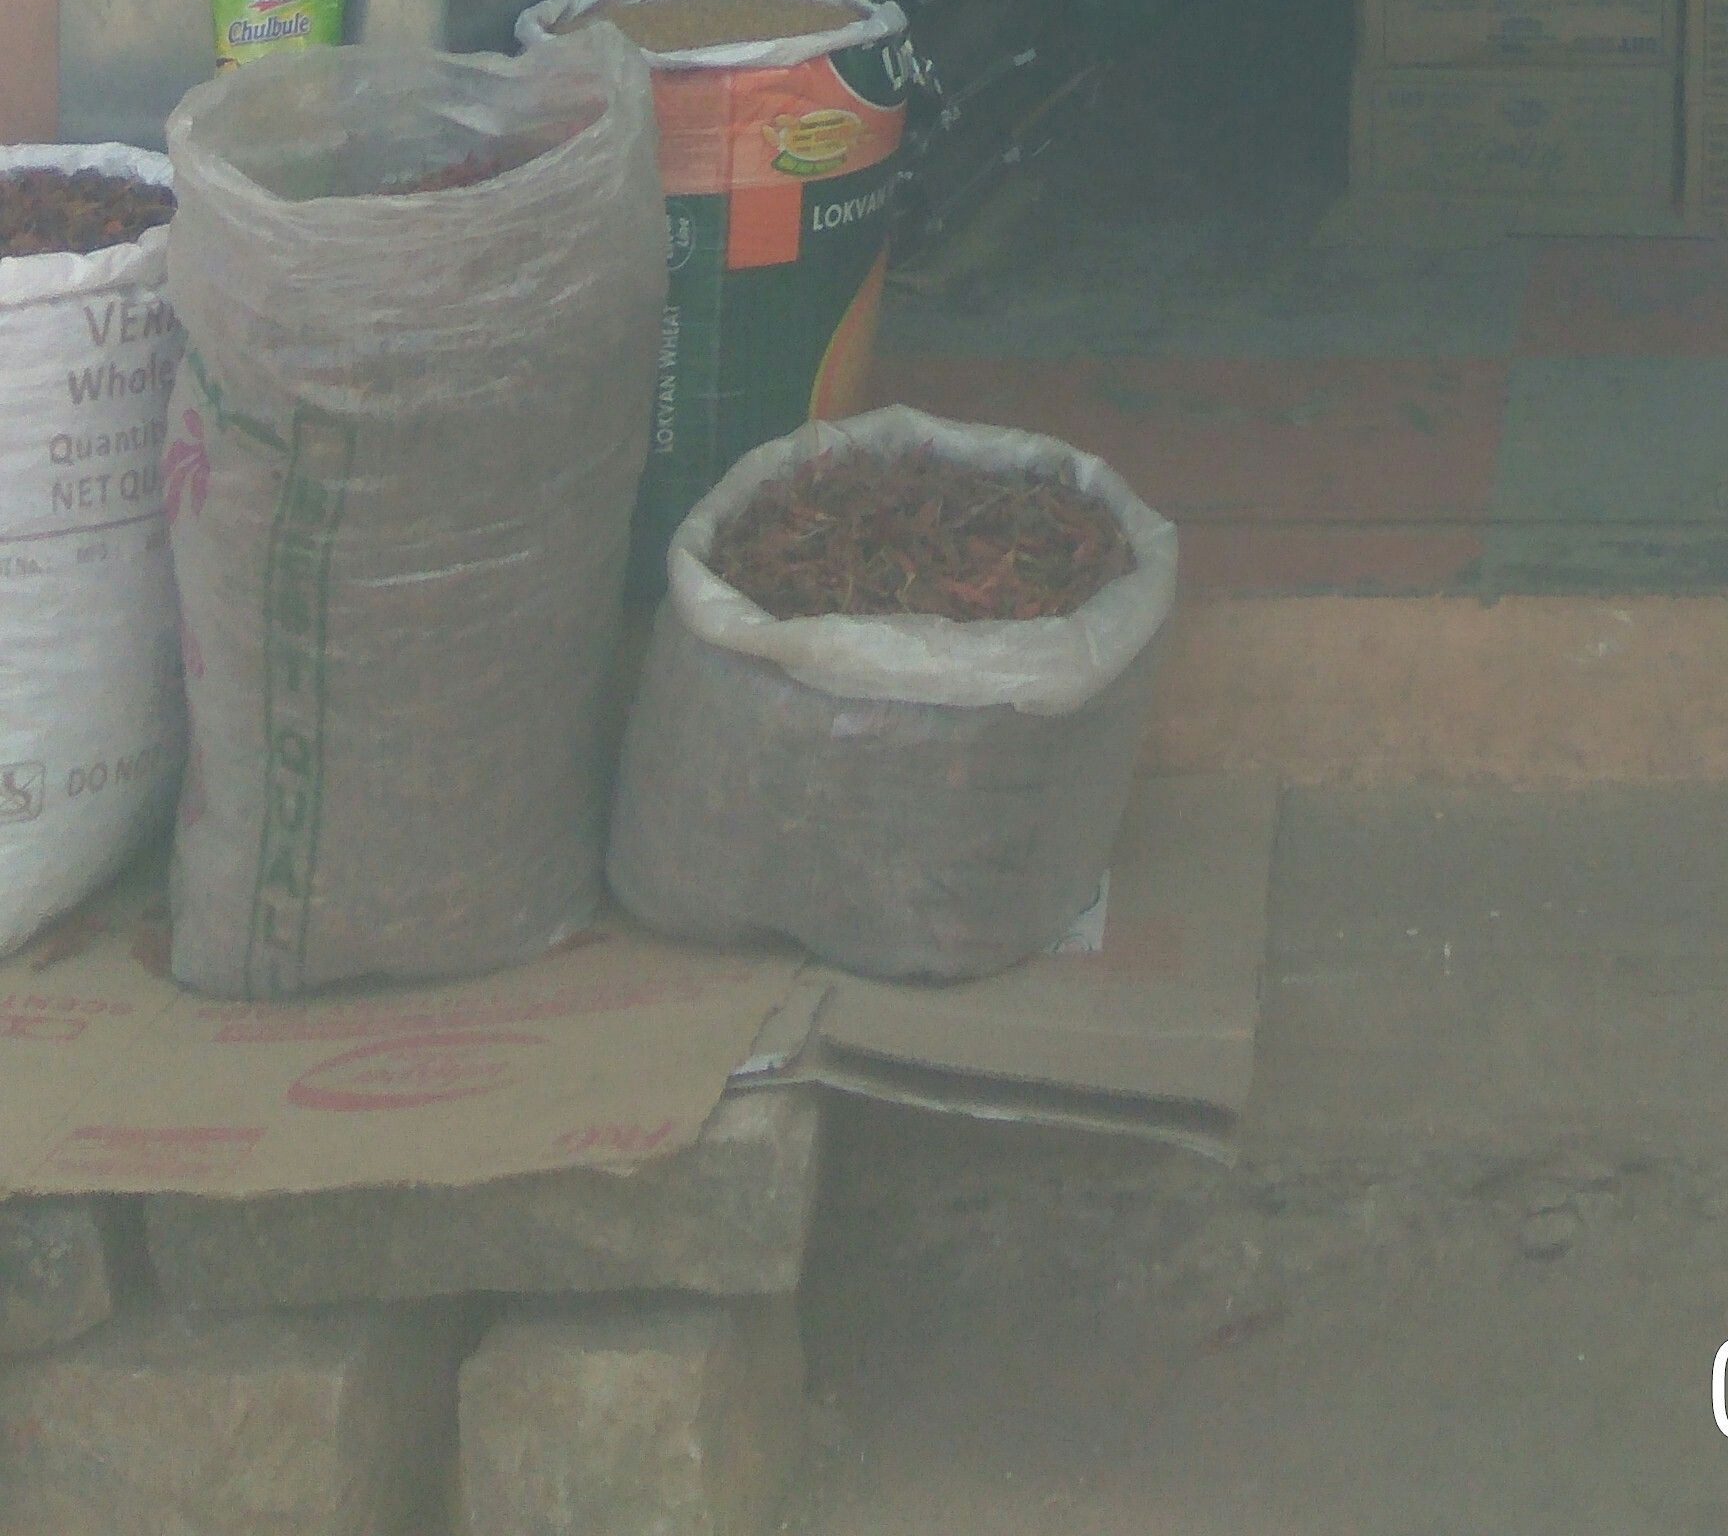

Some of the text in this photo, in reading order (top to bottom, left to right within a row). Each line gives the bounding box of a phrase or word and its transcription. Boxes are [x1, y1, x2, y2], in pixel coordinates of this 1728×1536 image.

[228, 13, 310, 45] Chulbule
[657, 304, 682, 371] WHEAT
[51, 474, 111, 512] NET
